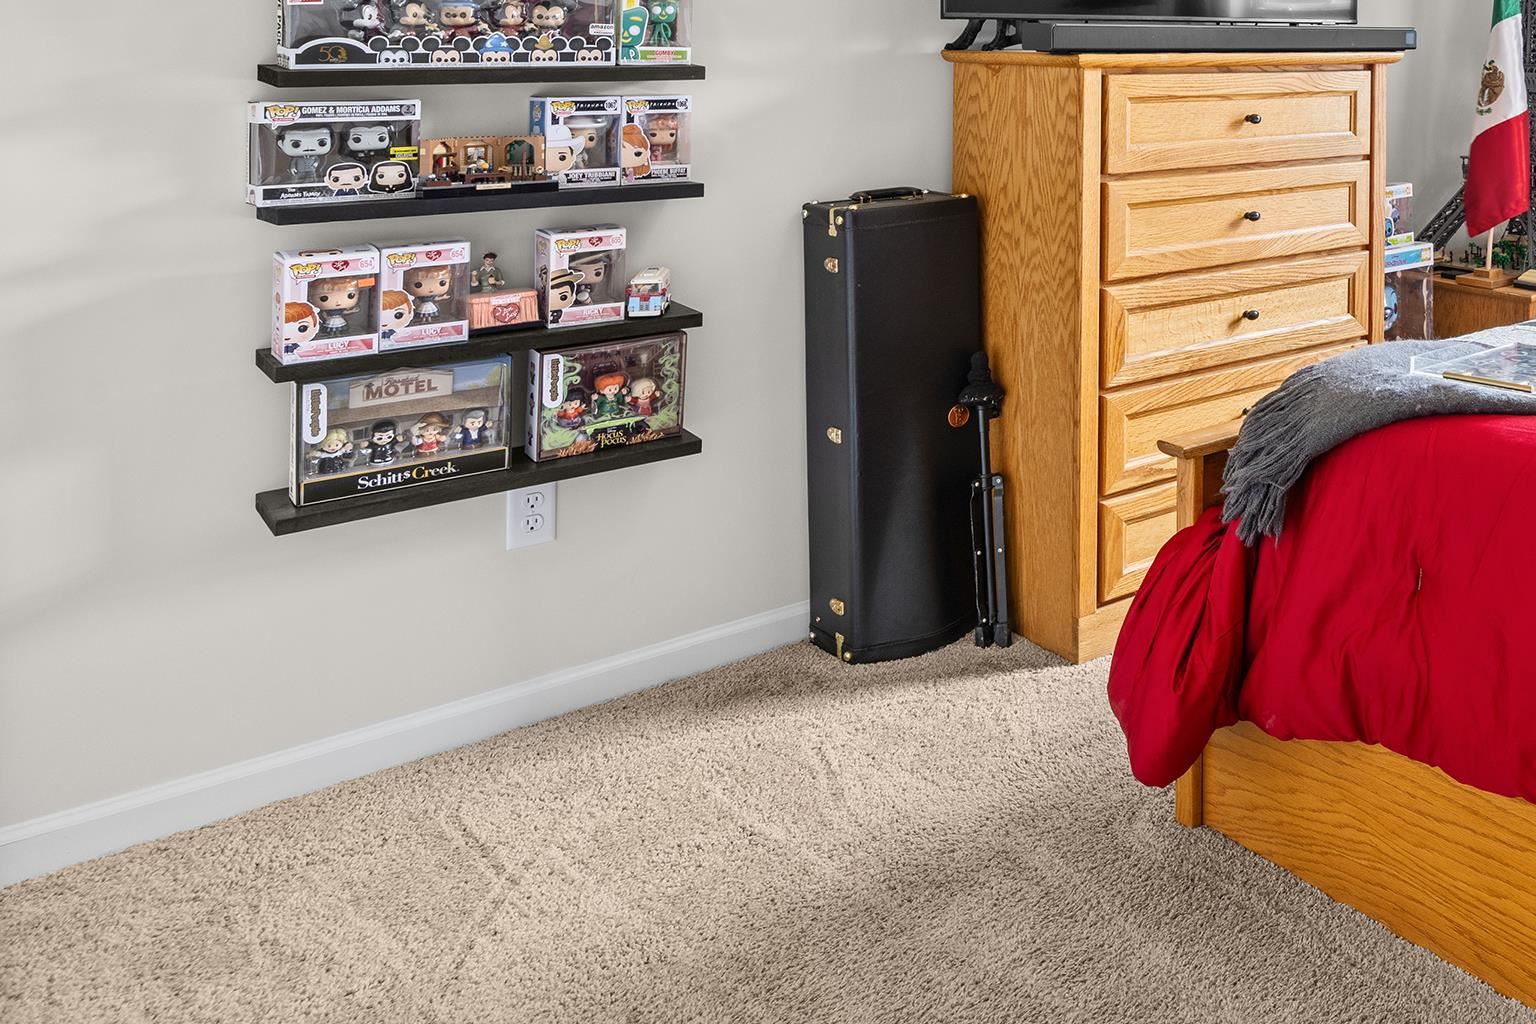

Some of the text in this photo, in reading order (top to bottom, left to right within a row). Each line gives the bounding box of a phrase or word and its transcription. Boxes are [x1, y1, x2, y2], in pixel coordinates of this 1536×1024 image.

[267, 104, 300, 119] POP!
[302, 106, 327, 114] GOMEZ
[336, 105, 370, 113] MORTICIA
[371, 105, 400, 113] ADDAMS
[551, 100, 575, 112] POP!
[626, 100, 649, 111] POP!
[555, 239, 581, 251] POP!
[387, 253, 416, 265] POP!
[450, 249, 464, 259] 654
[289, 263, 321, 276] POP!
[359, 259, 373, 269] 654
[421, 327, 442, 336] LUCY
[328, 340, 349, 350] LUCY
[364, 379, 438, 401] MOTEL
